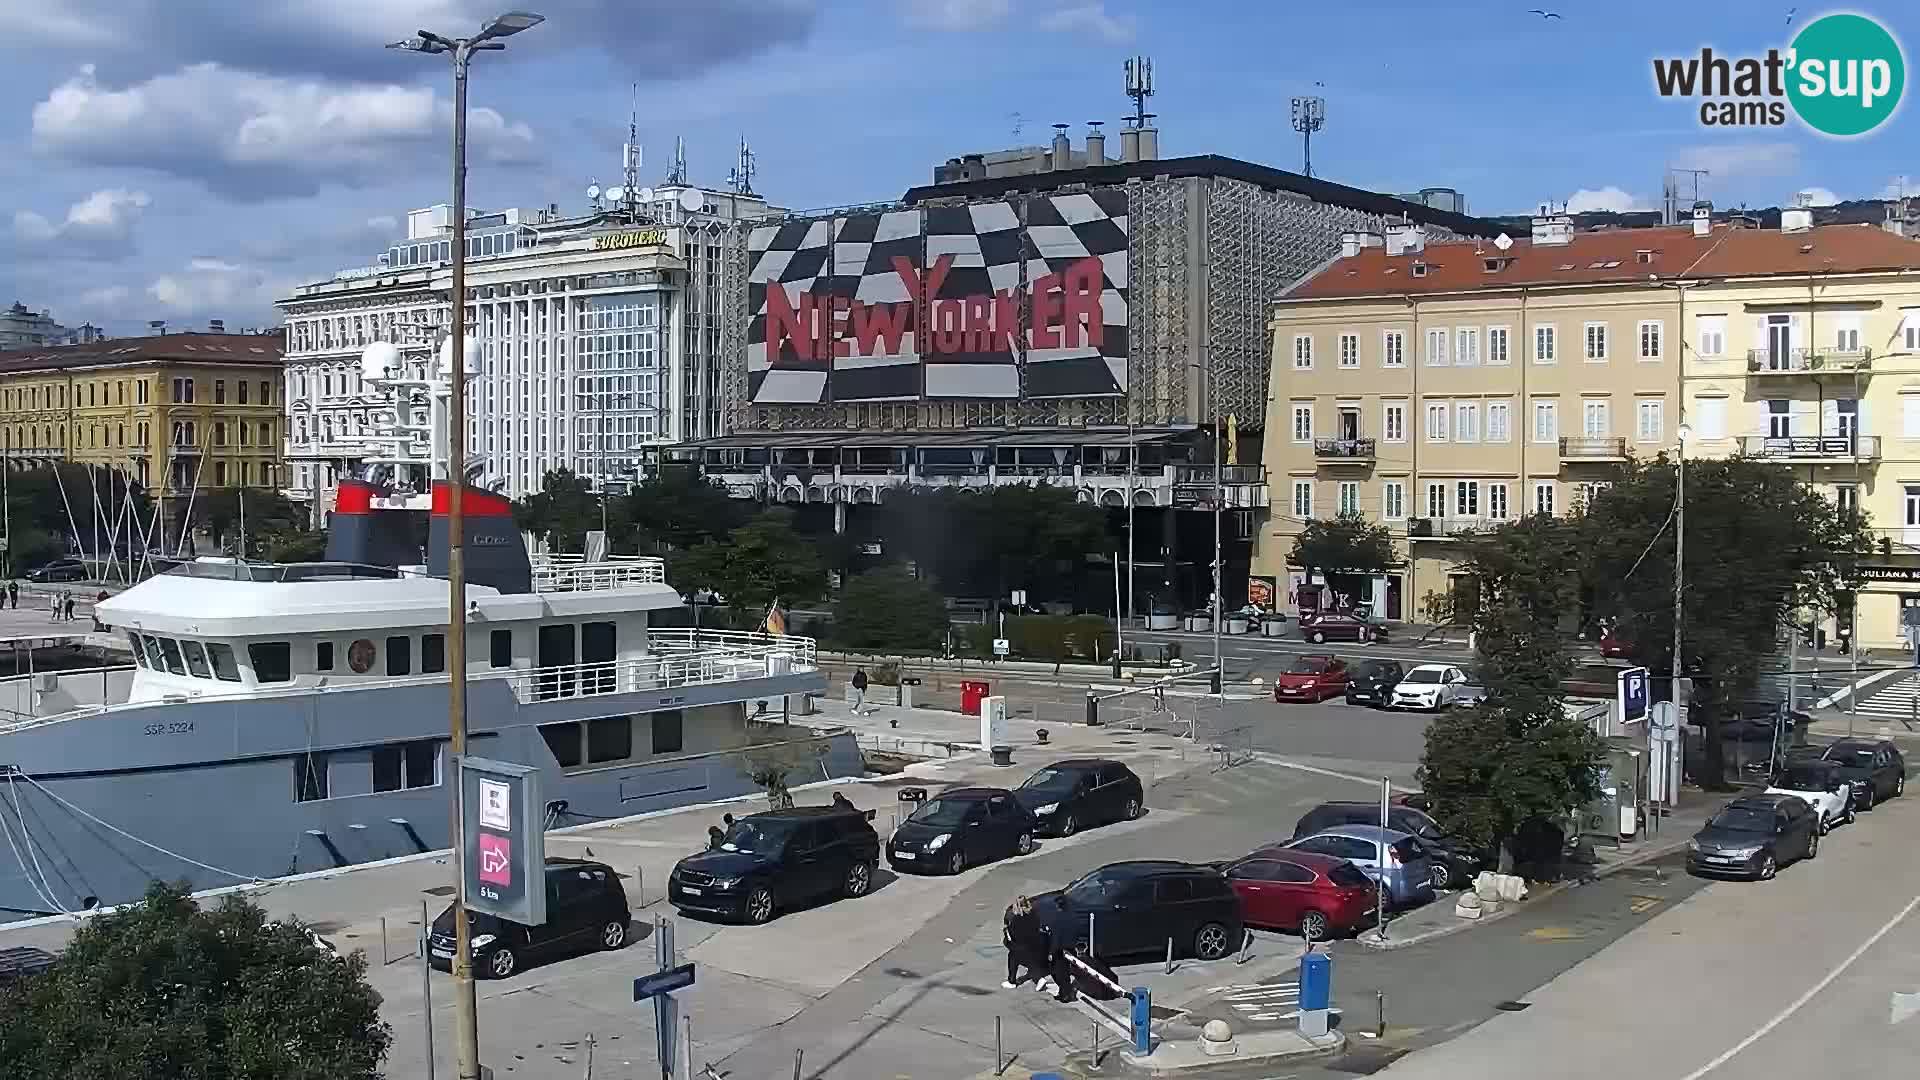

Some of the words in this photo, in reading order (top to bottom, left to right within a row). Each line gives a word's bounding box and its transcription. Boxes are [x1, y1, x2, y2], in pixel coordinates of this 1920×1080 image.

[766, 277, 908, 364] NEW
[890, 255, 1105, 354] YORKER
[1860, 570, 1909, 578] JULIANA
